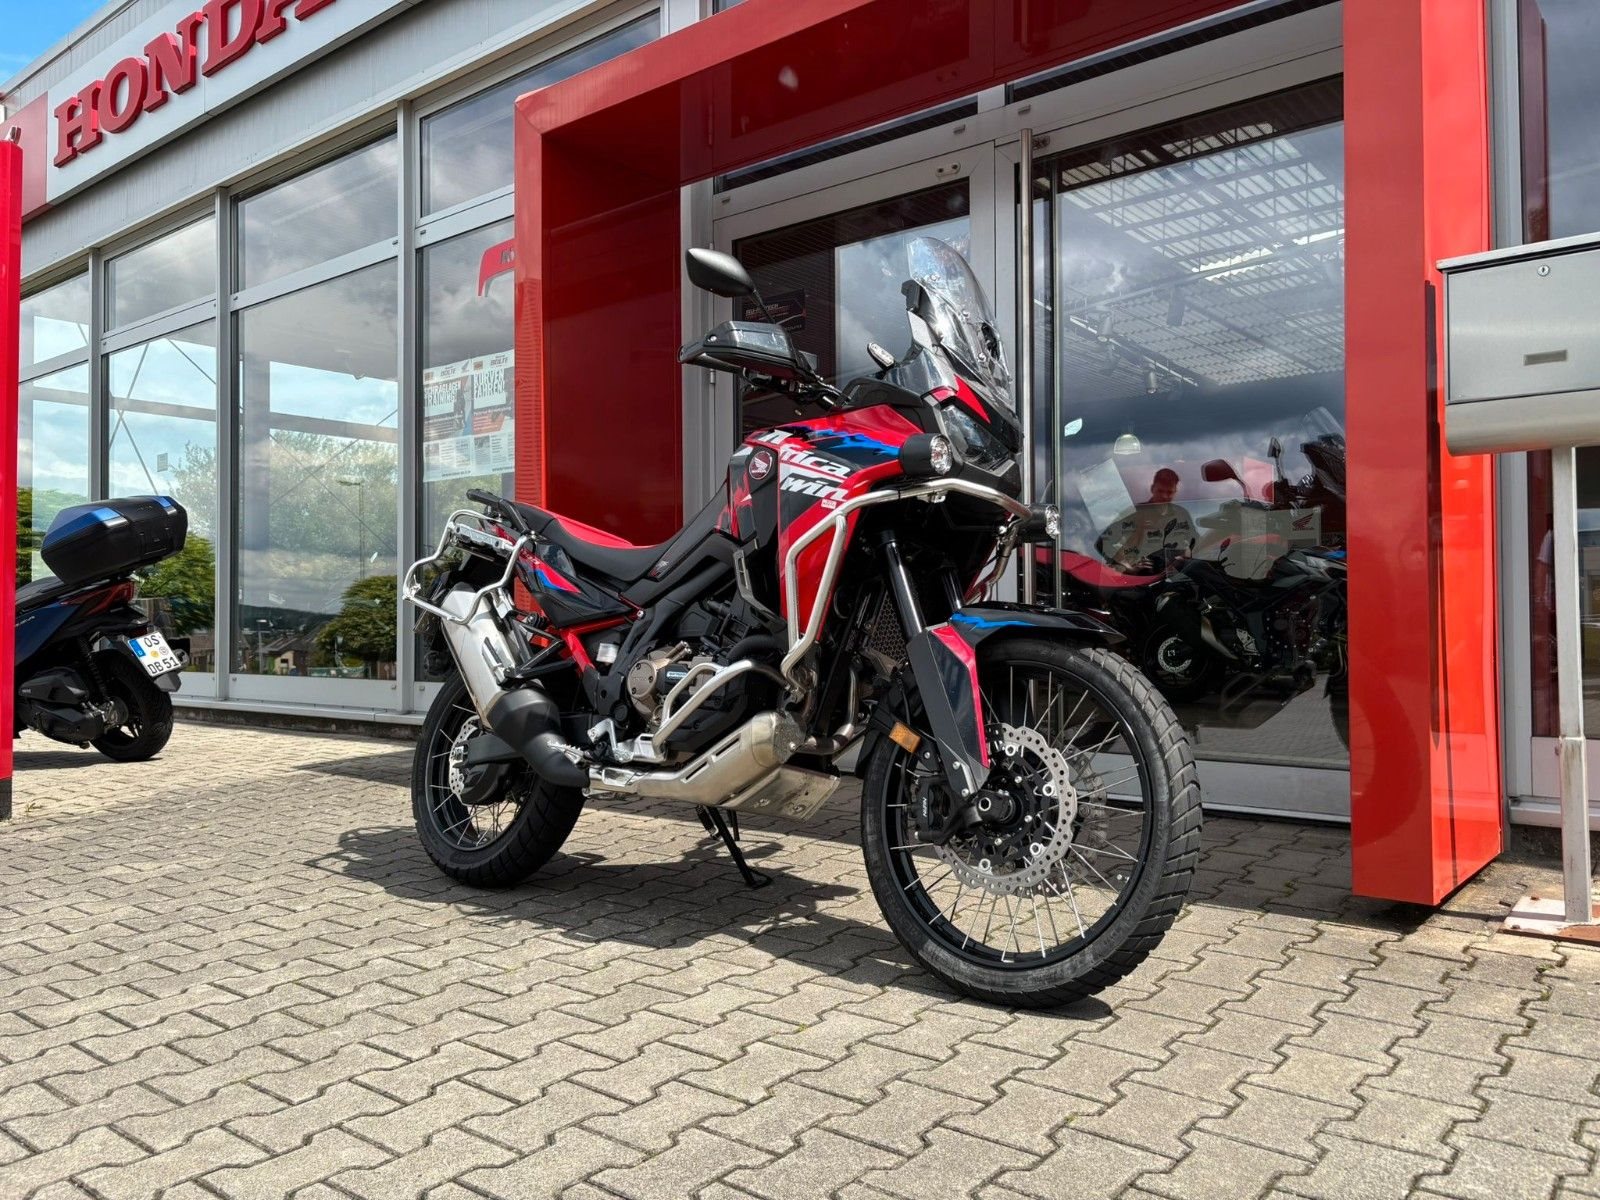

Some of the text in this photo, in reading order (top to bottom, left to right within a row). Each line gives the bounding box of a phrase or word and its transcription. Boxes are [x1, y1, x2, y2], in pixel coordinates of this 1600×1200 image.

[143, 634, 160, 648] OS
[147, 656, 179, 674] DB 51
